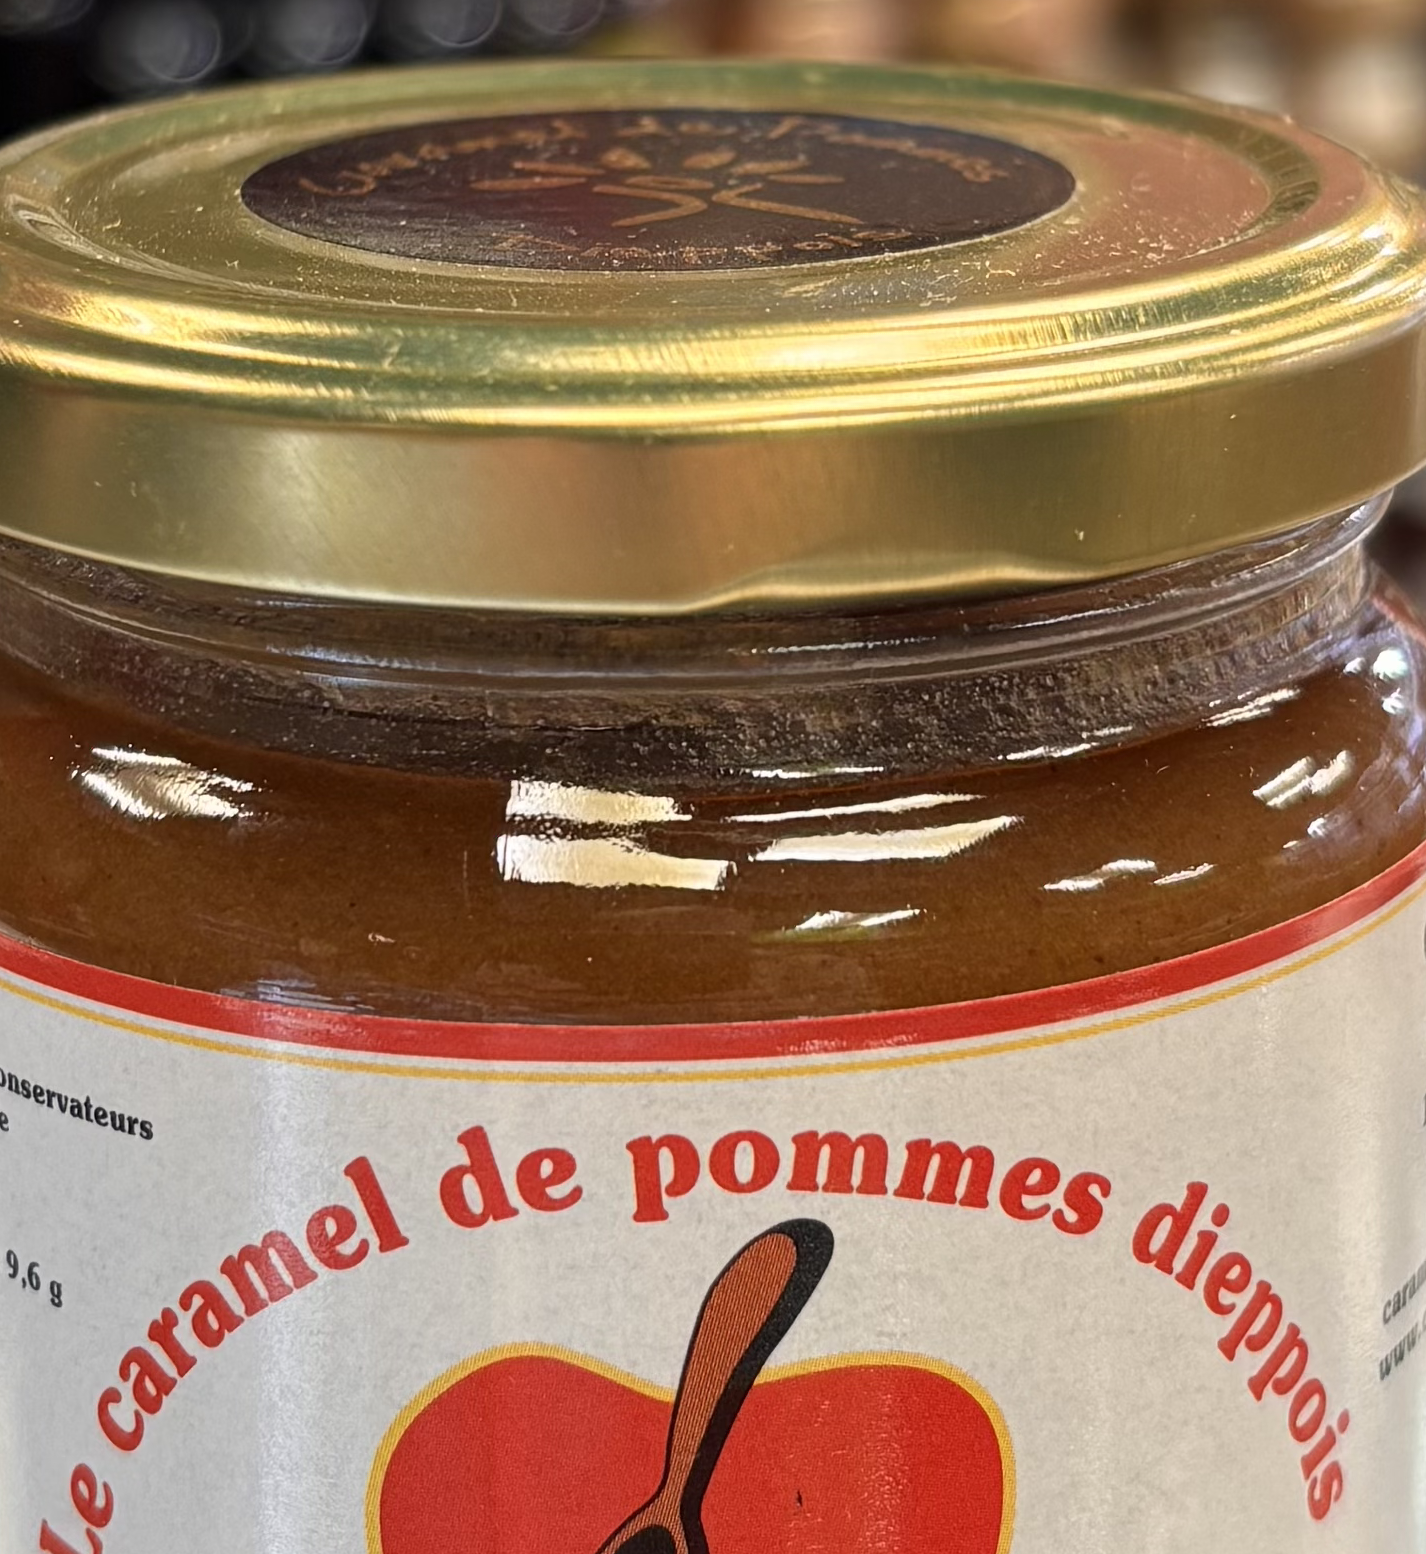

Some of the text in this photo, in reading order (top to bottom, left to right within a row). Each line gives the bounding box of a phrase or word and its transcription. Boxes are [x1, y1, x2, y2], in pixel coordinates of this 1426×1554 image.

[6, 1249, 41, 1291] 9,6
[49, 1280, 63, 1308] g
[96, 1155, 410, 1452] caramel
[438, 1125, 584, 1230] de
[625, 1129, 1113, 1235] pommes
[1131, 1180, 1351, 1522] dieppois
